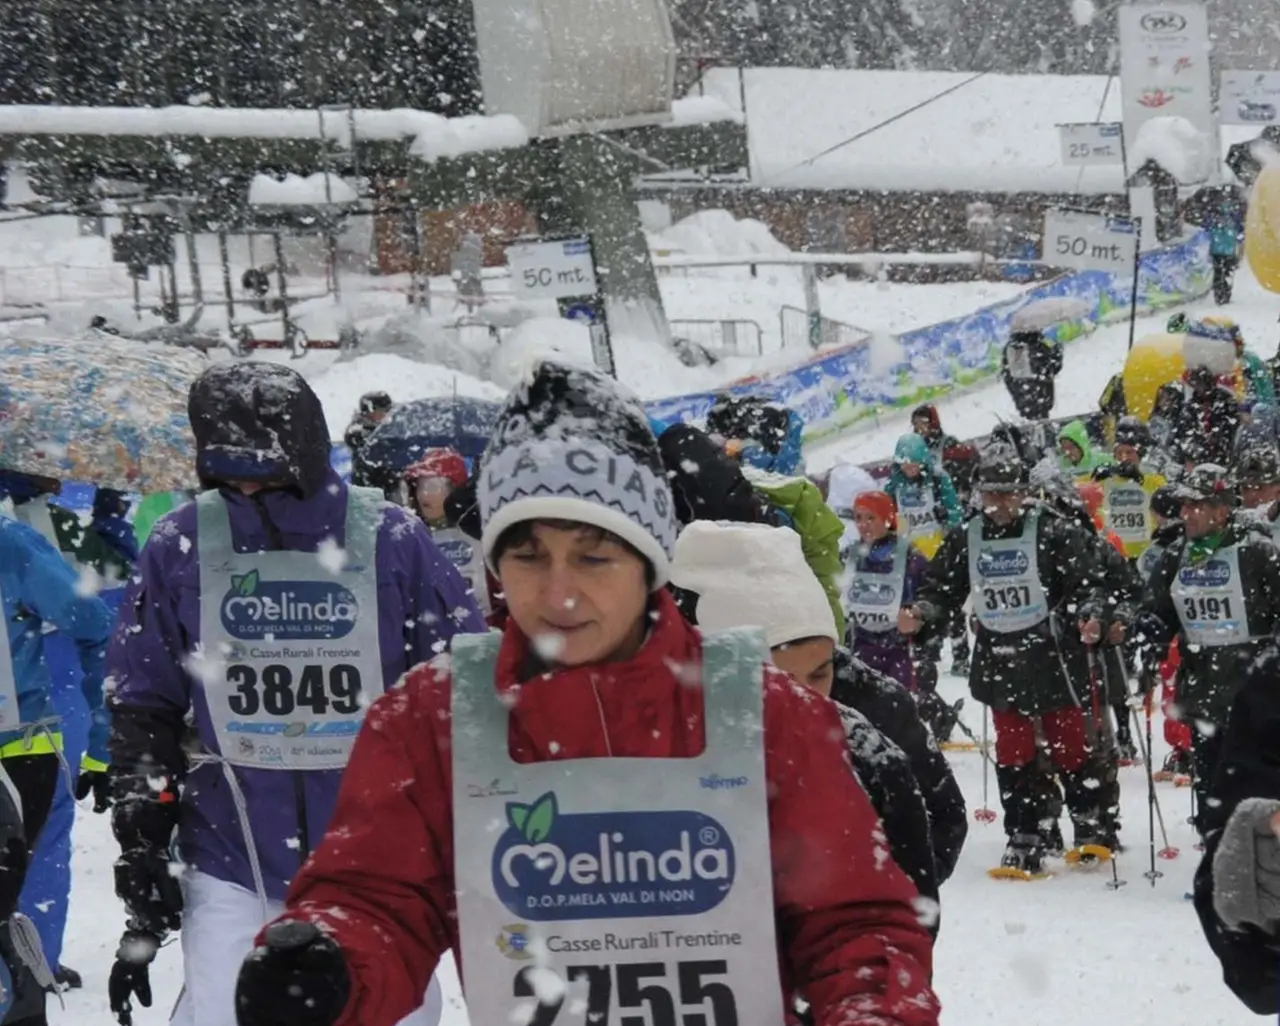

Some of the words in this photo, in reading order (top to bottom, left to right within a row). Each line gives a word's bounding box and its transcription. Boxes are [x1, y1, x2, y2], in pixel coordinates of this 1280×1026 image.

[1056, 235, 1087, 256] 50
[1092, 243, 1125, 262] mt.
[225, 592, 357, 622] Melinda
[250, 649, 281, 659] Casse
[283, 648, 314, 659] Rurali
[316, 647, 361, 658] Trentine
[226, 664, 362, 717] 3849
[501, 830, 729, 888] Melinda
[609, 892, 637, 904] VAL
[641, 892, 655, 904] DI
[658, 889, 695, 903] NON
[546, 934, 600, 952] Casse
[604, 931, 659, 950] Rurali
[660, 929, 742, 948] Trentine
